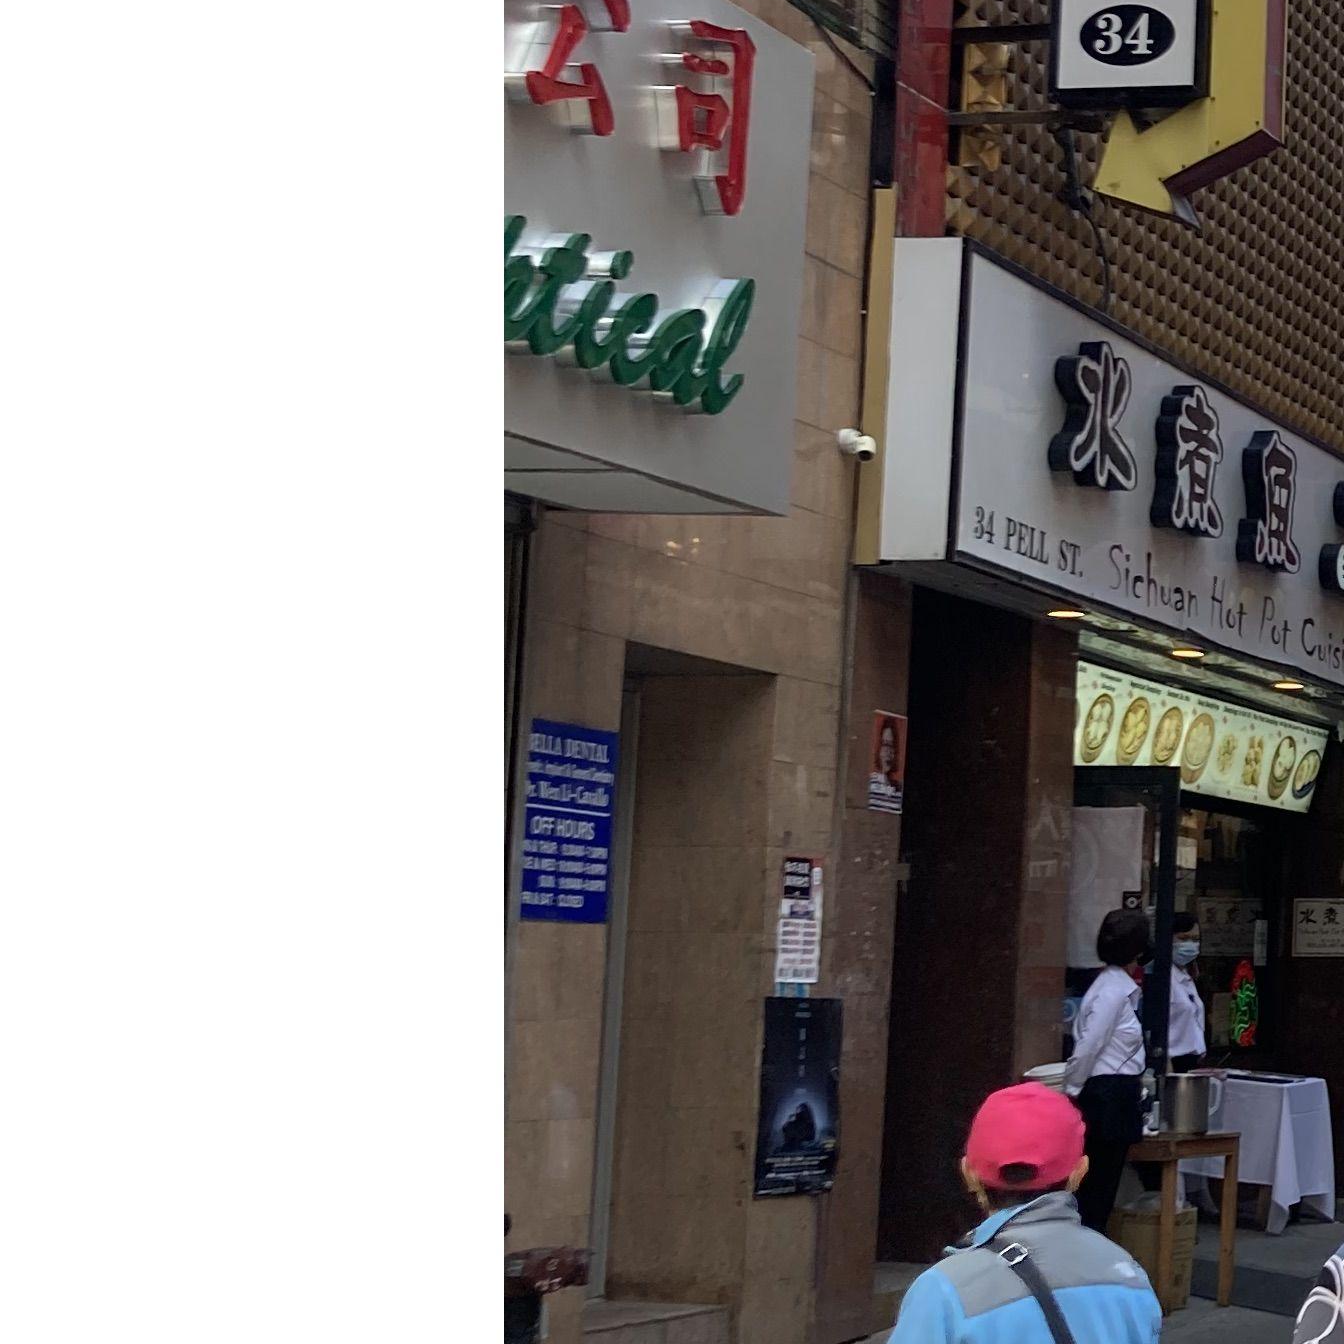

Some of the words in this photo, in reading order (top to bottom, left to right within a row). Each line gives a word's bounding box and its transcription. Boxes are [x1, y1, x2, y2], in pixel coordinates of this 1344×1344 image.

[1092, 14, 1154, 56] 34
[973, 505, 996, 544] 34
[1004, 516, 1049, 565] PELL
[1057, 540, 1083, 578] ST.
[1108, 543, 1198, 620] Sichuan
[1211, 575, 1247, 639] Hot
[1258, 595, 1290, 653] Pot
